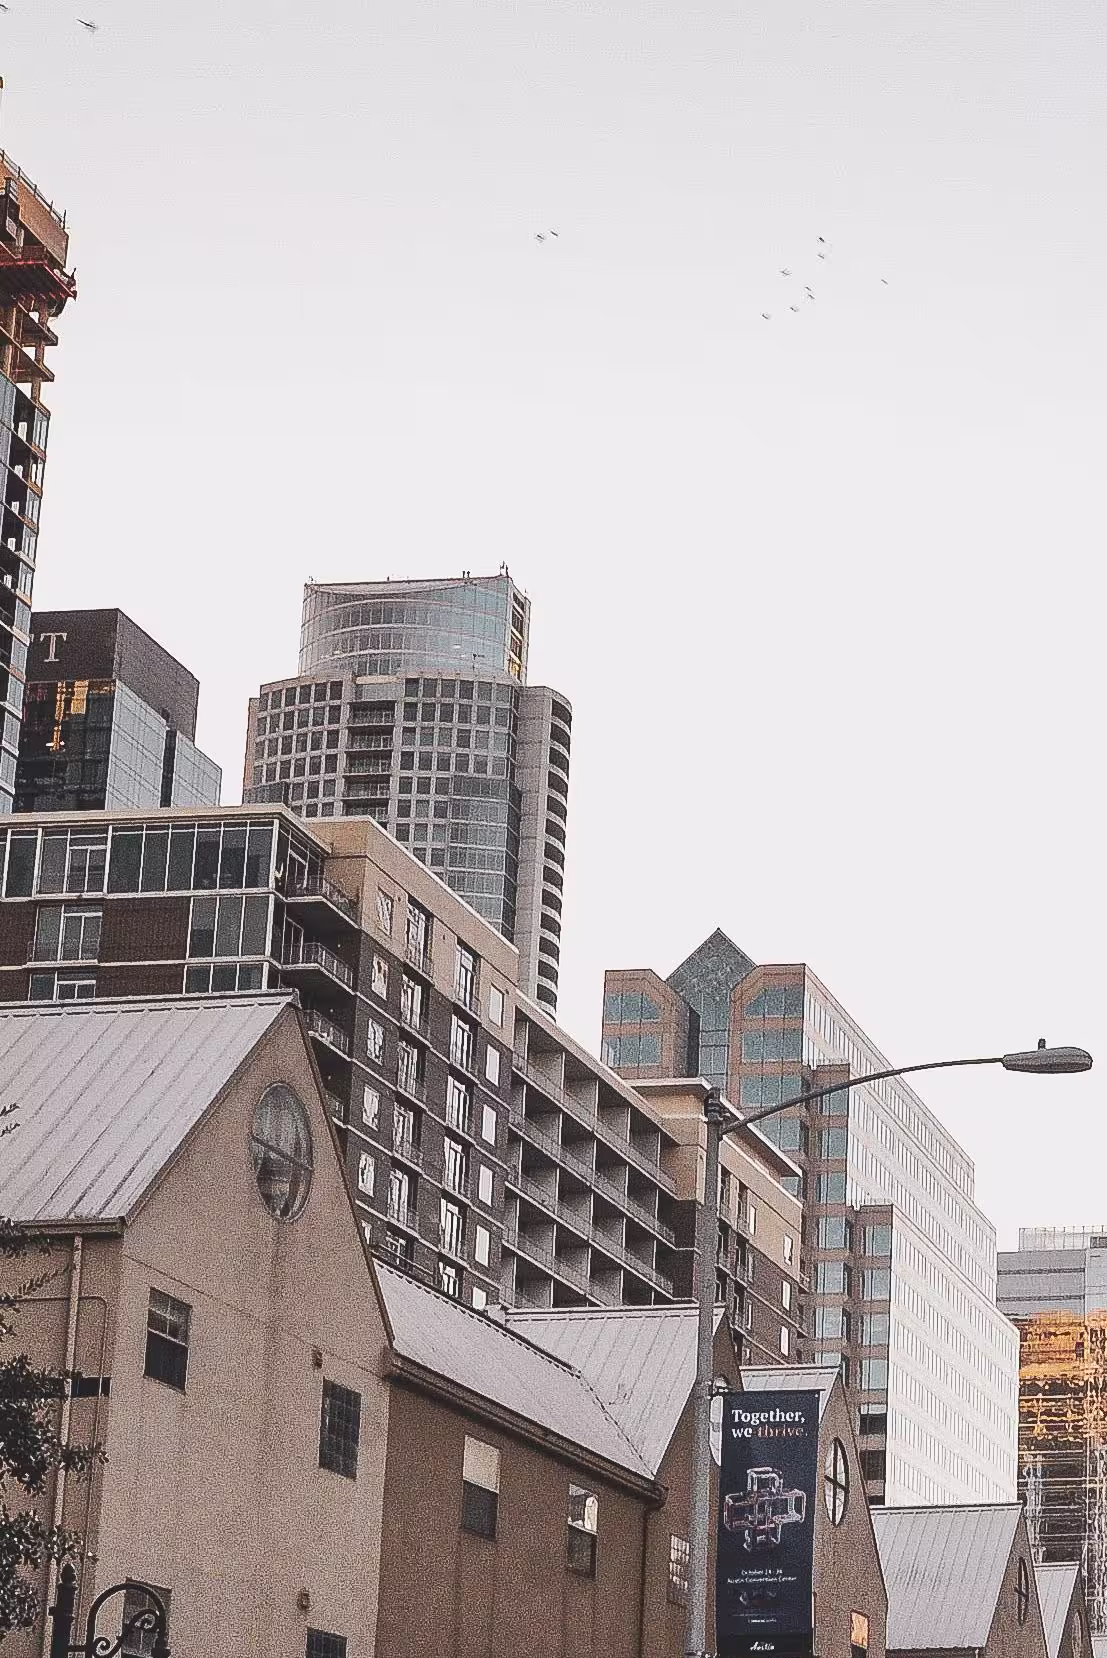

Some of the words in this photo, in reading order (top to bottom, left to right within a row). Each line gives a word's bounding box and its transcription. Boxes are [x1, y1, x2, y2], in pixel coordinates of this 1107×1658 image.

[30, 632, 68, 662] T
[731, 1407, 806, 1426] Together,
[731, 1427, 753, 1438] we
